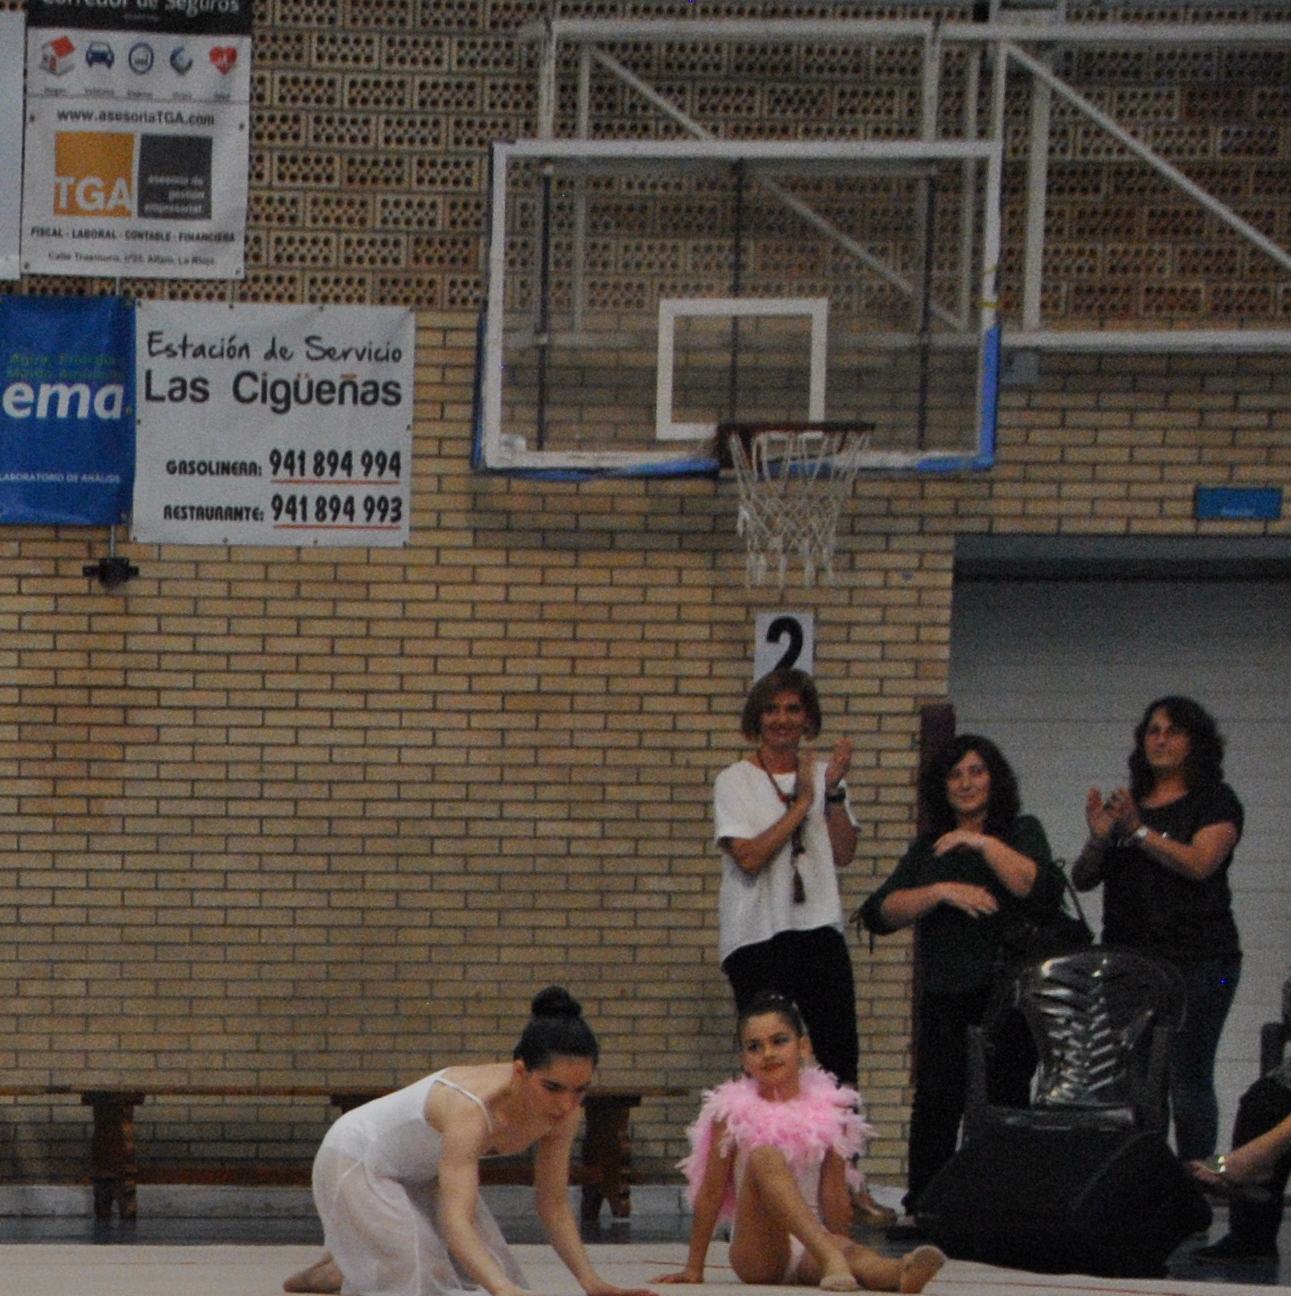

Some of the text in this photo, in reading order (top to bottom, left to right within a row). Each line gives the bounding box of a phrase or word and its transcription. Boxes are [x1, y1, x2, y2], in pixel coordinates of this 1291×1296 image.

[54, 176, 133, 211] TGA
[30, 225, 235, 243] FISCAL LABORAL CONTABLE FINANCIERA
[147, 331, 251, 362] Estación
[263, 336, 294, 362] de
[304, 335, 403, 363] Servicio
[144, 369, 403, 415] Las Cigüeñas
[165, 448, 402, 478] GASOLINERA: 941 894 994
[163, 494, 403, 523] RESTAURANTE: 941 894 993
[766, 616, 803, 673] 2
